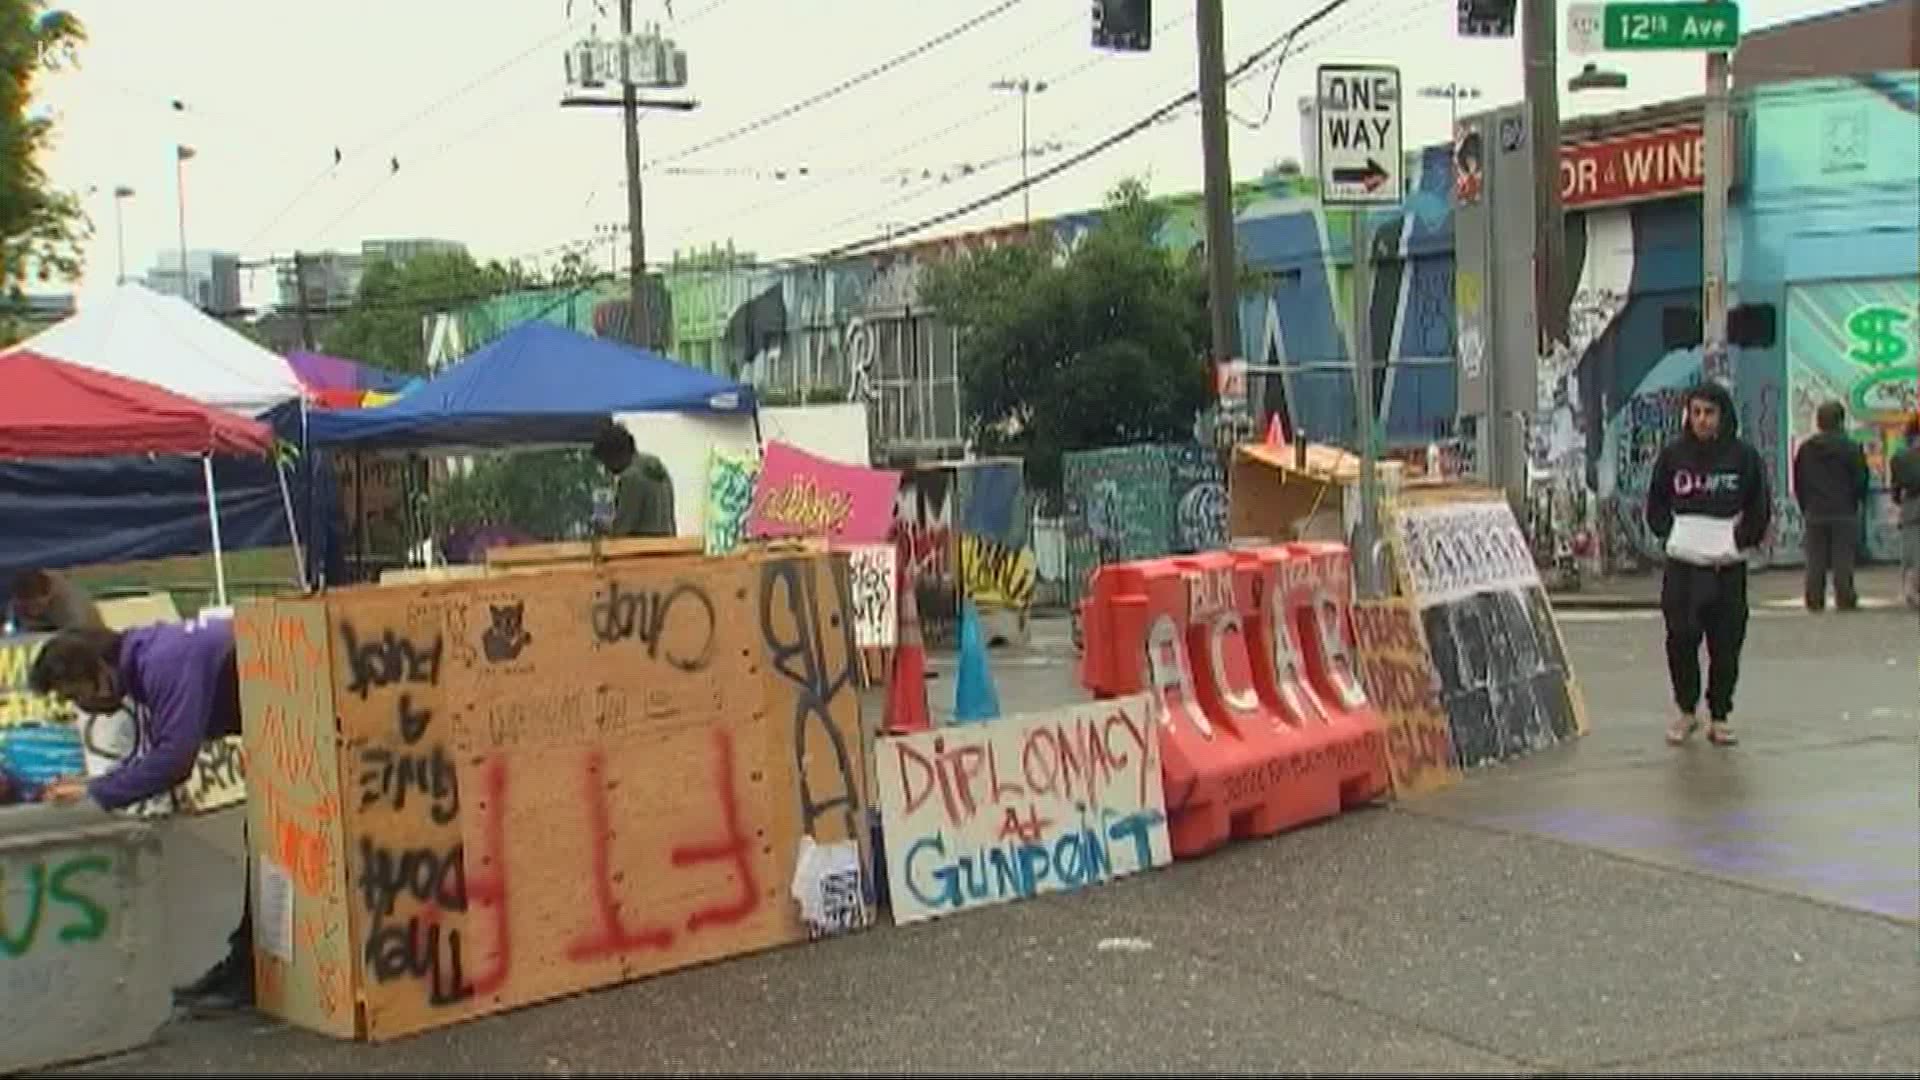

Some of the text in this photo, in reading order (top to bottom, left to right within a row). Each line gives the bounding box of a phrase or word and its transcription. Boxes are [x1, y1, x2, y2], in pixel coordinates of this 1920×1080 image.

[1683, 15, 1727, 40] Ave
[1327, 76, 1393, 111] ONE
[1328, 118, 1391, 150] WAY
